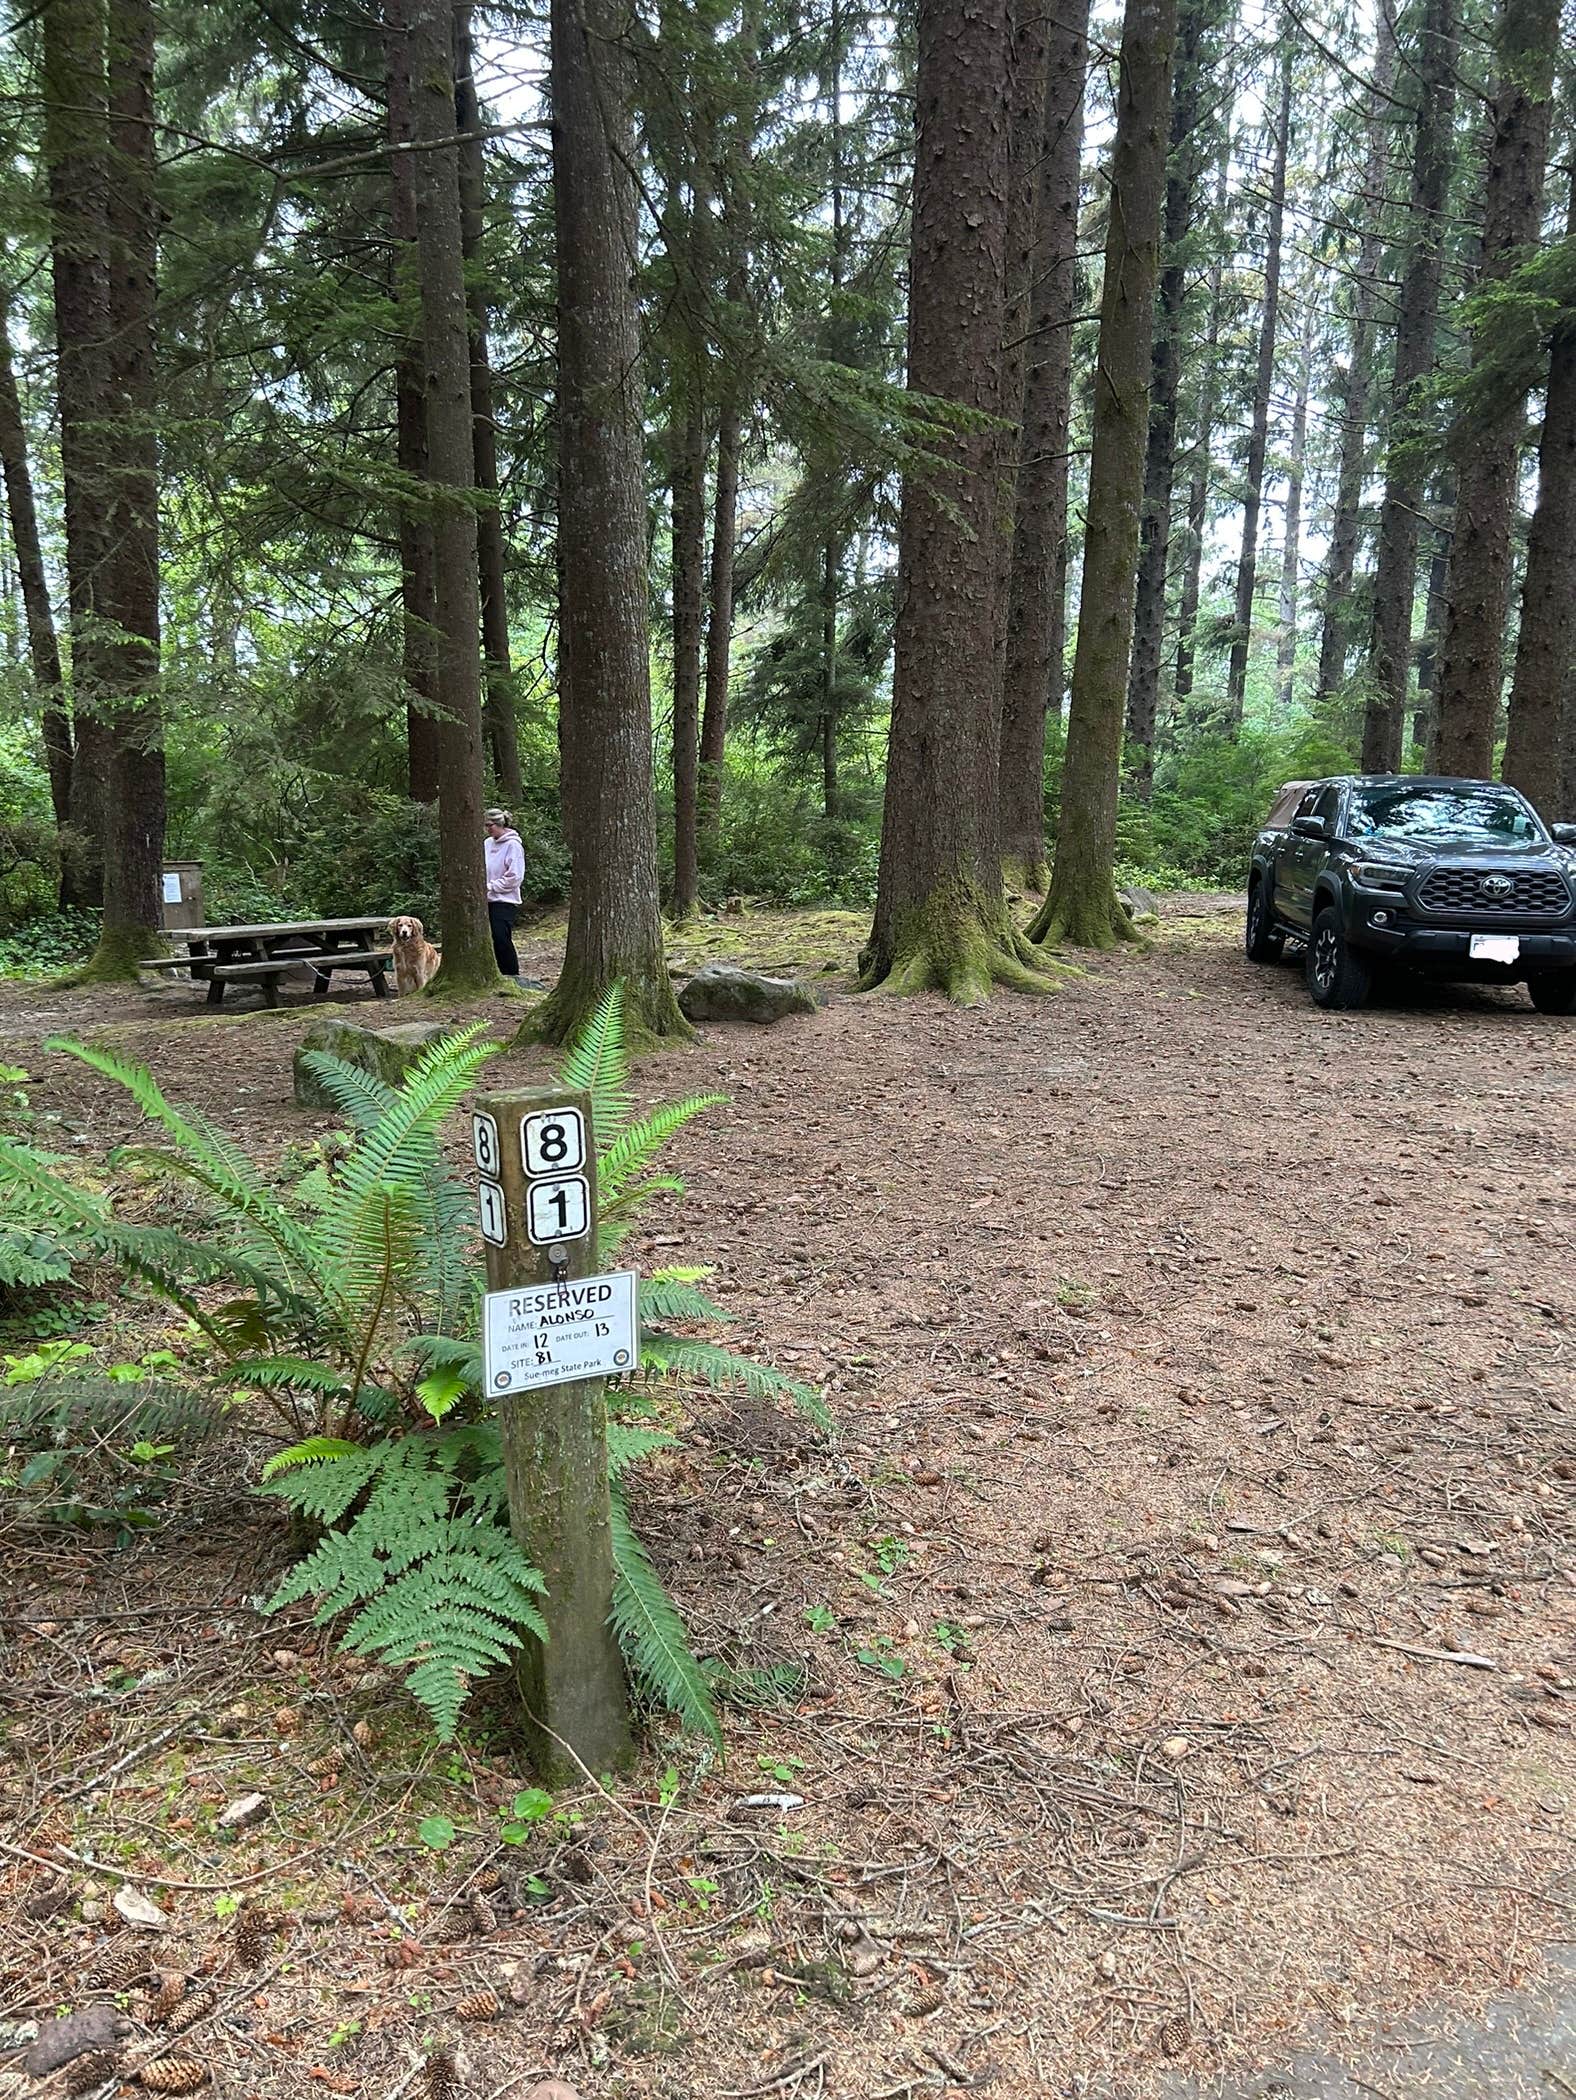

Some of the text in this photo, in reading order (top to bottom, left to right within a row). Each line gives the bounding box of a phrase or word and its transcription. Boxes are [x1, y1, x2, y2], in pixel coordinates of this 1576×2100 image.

[478, 1126, 491, 1164] 8
[540, 1123, 568, 1162] 8
[486, 1193, 496, 1231] 1
[548, 1189, 567, 1229] 1
[509, 1284, 612, 1317] RESERVED
[508, 1308, 594, 1333] NAME: ALONSO
[501, 1343, 518, 1353] DATE
[533, 1333, 549, 1349] 12
[555, 1333, 572, 1343] DATE
[573, 1331, 590, 1340] OUT:
[595, 1322, 610, 1337] 13
[511, 1351, 552, 1369] SITE: 81
[524, 1367, 560, 1380] Sue-meg
[561, 1362, 582, 1374] State
[583, 1358, 602, 1369] Park
